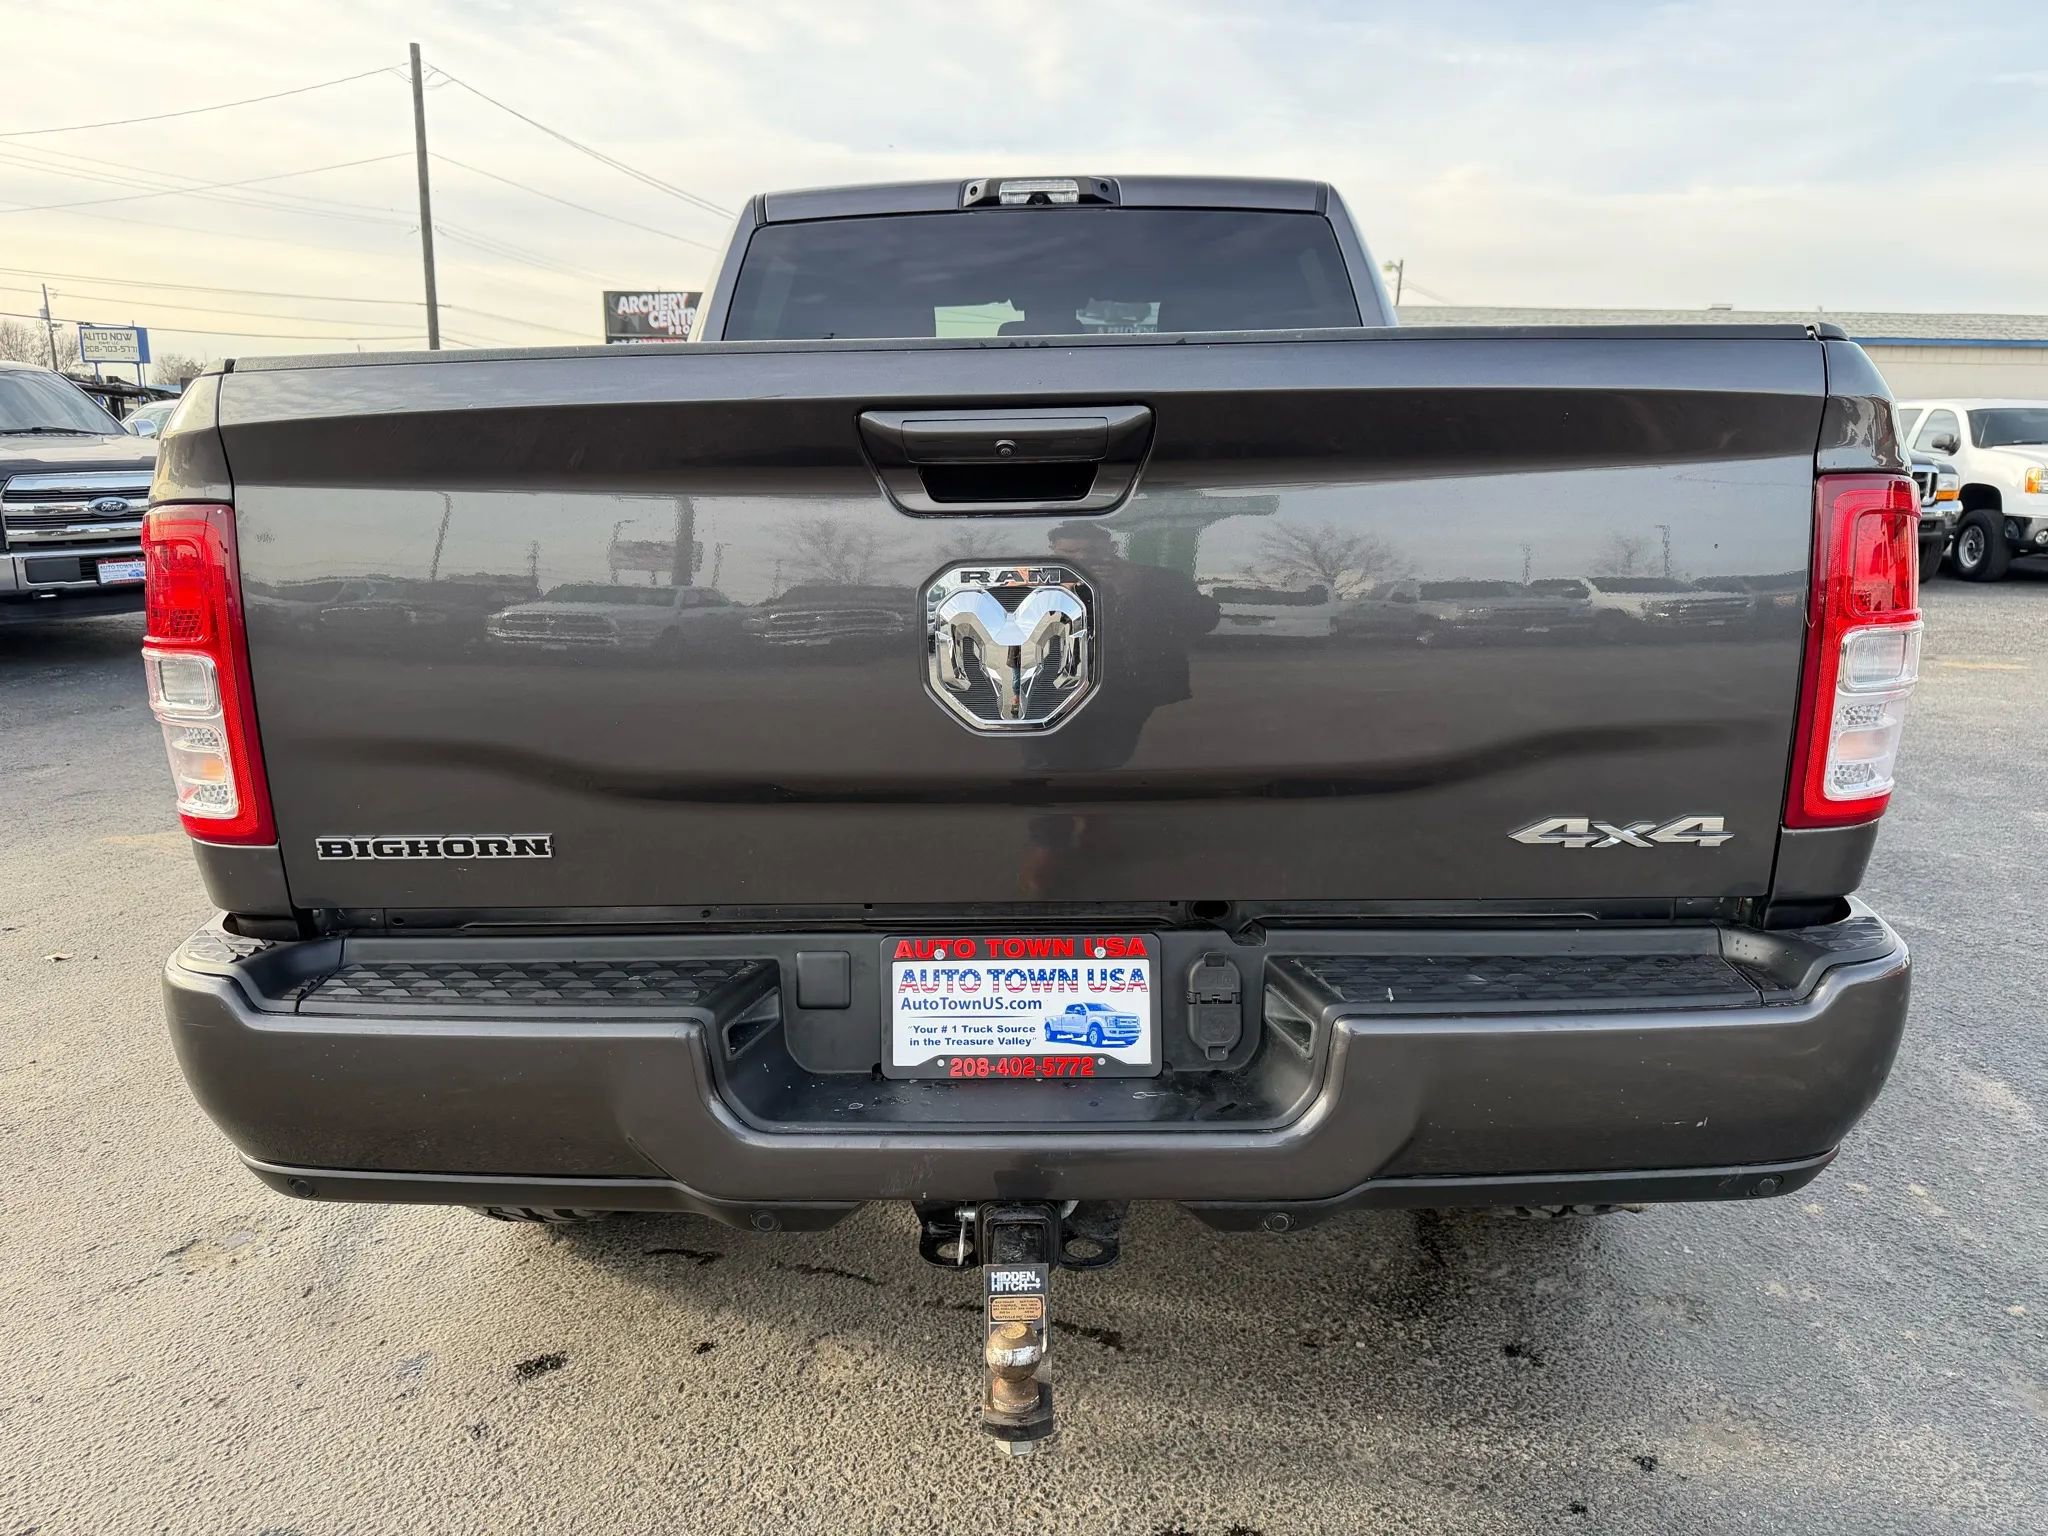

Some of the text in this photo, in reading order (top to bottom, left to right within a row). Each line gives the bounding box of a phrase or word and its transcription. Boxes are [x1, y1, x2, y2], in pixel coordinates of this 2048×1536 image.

[617, 293, 688, 316] ARCHERY
[83, 332, 132, 341] AUTO NOW
[668, 325, 690, 336] PRO
[101, 501, 123, 511] Ford
[961, 568, 1061, 585] RAM
[315, 834, 553, 860] BIGHORN
[893, 937, 1148, 960] AUTO TOWN USA
[898, 968, 1148, 993] AUTO TOWN USA
[900, 997, 1042, 1011] AutoTownUS.com
[952, 1025, 957, 1033] 1
[961, 1024, 993, 1033] Truck
[997, 1025, 1036, 1033] Source
[909, 1038, 920, 1046] in
[923, 1038, 941, 1046] the
[945, 1037, 994, 1046] Treasure
[949, 1057, 1095, 1078] 208-402-5772
[991, 1271, 1036, 1282] HIDDEN
[991, 1281, 1028, 1292] HITCH
